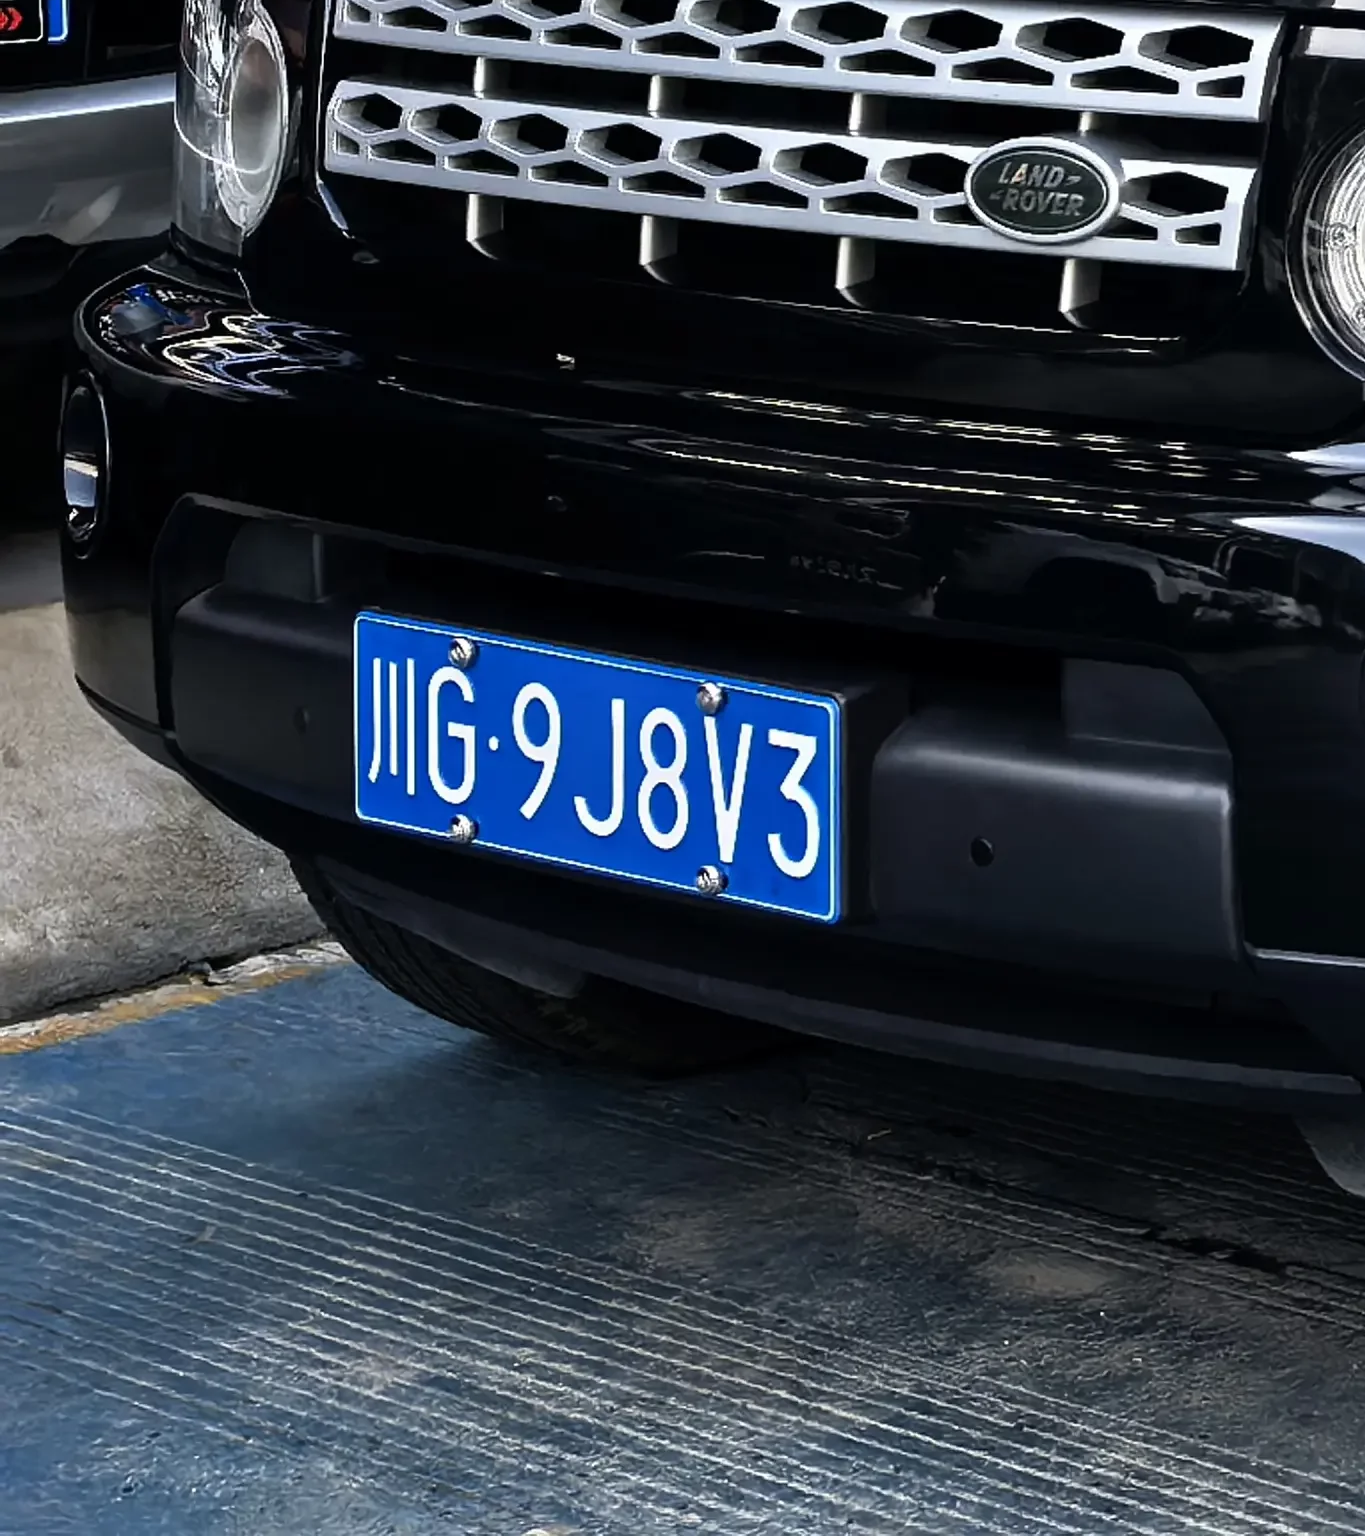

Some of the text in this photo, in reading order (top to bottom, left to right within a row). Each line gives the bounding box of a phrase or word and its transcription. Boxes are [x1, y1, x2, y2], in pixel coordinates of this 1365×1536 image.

[998, 161, 1065, 188] LAND
[1002, 188, 1085, 216] ROVER
[367, 657, 820, 878] 川G·9J8V3
